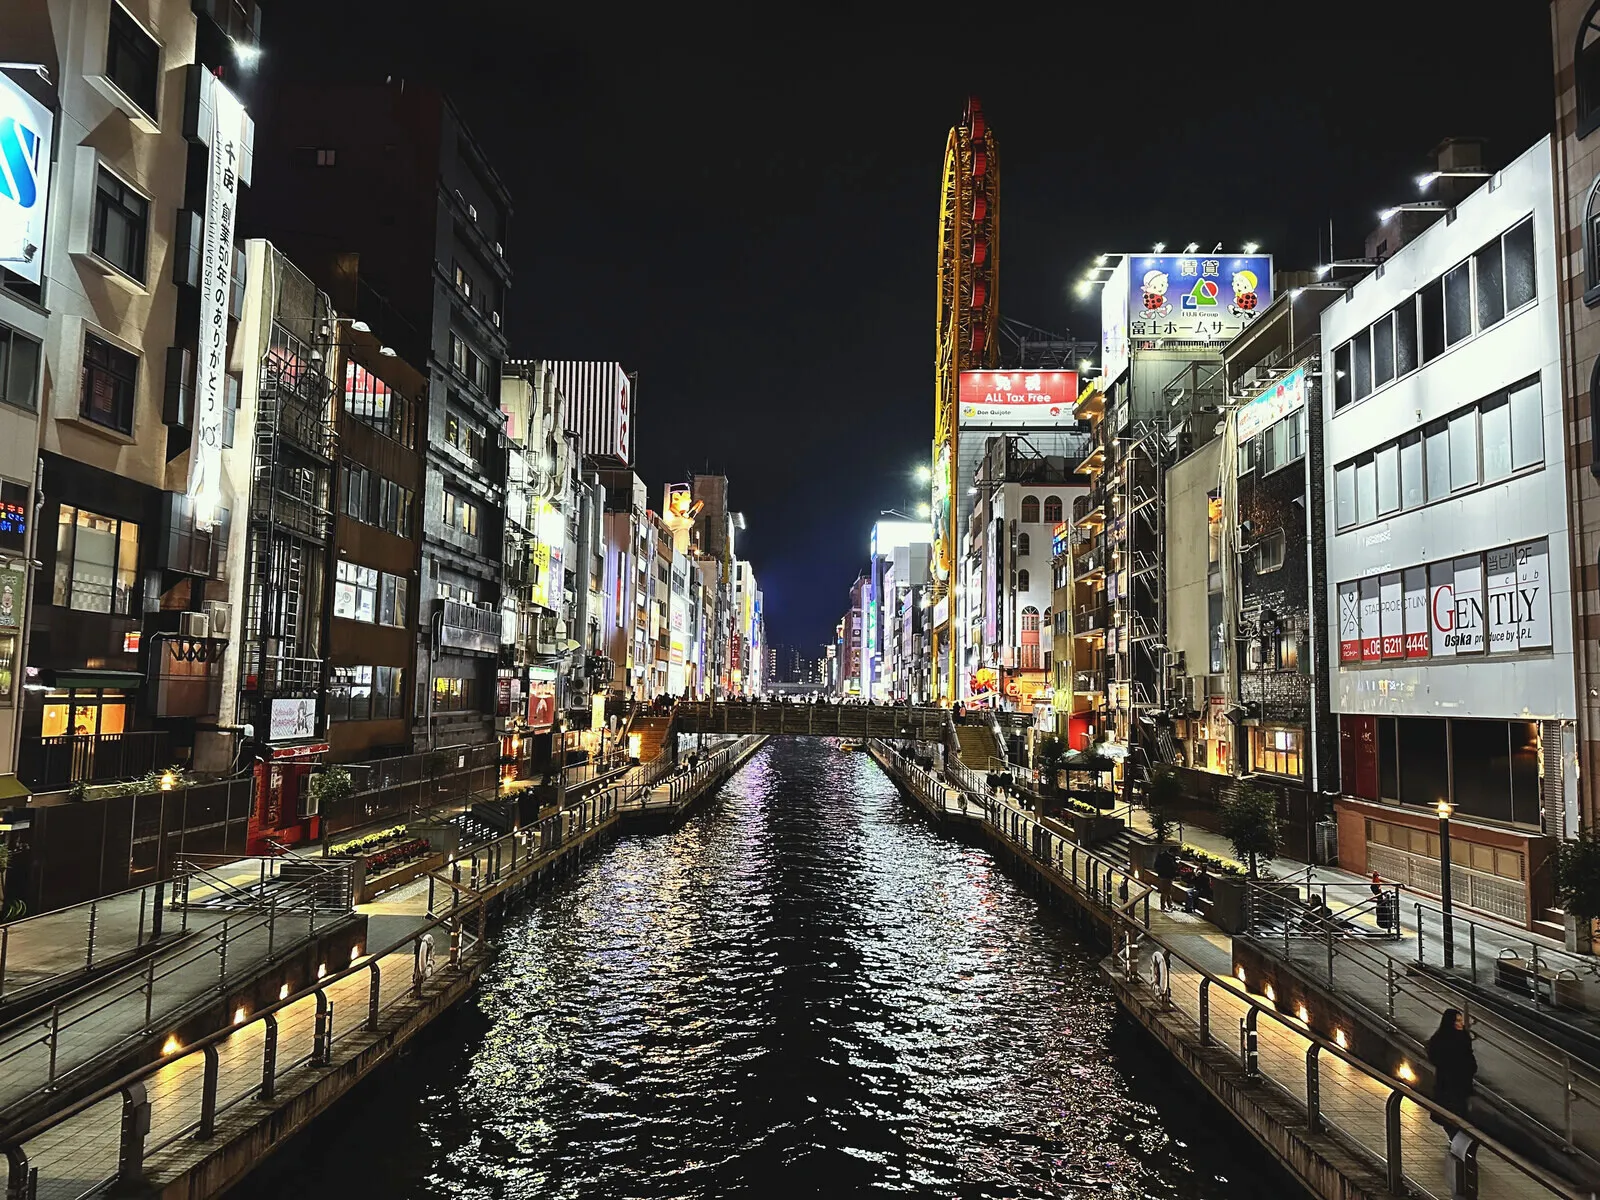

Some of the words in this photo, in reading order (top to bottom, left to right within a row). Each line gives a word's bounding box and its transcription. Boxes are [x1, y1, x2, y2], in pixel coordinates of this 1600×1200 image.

[1181, 260, 1220, 277] 賃貸
[985, 393, 1003, 402] ALL
[1006, 393, 1025, 402] Tax
[1028, 393, 1051, 402] Free
[1505, 570, 1539, 584] cub
[1433, 585, 1540, 633] GENTLY
[1383, 637, 1402, 654] 6211
[1444, 632, 1472, 647] Osaka
[1505, 630, 1515, 642] by
